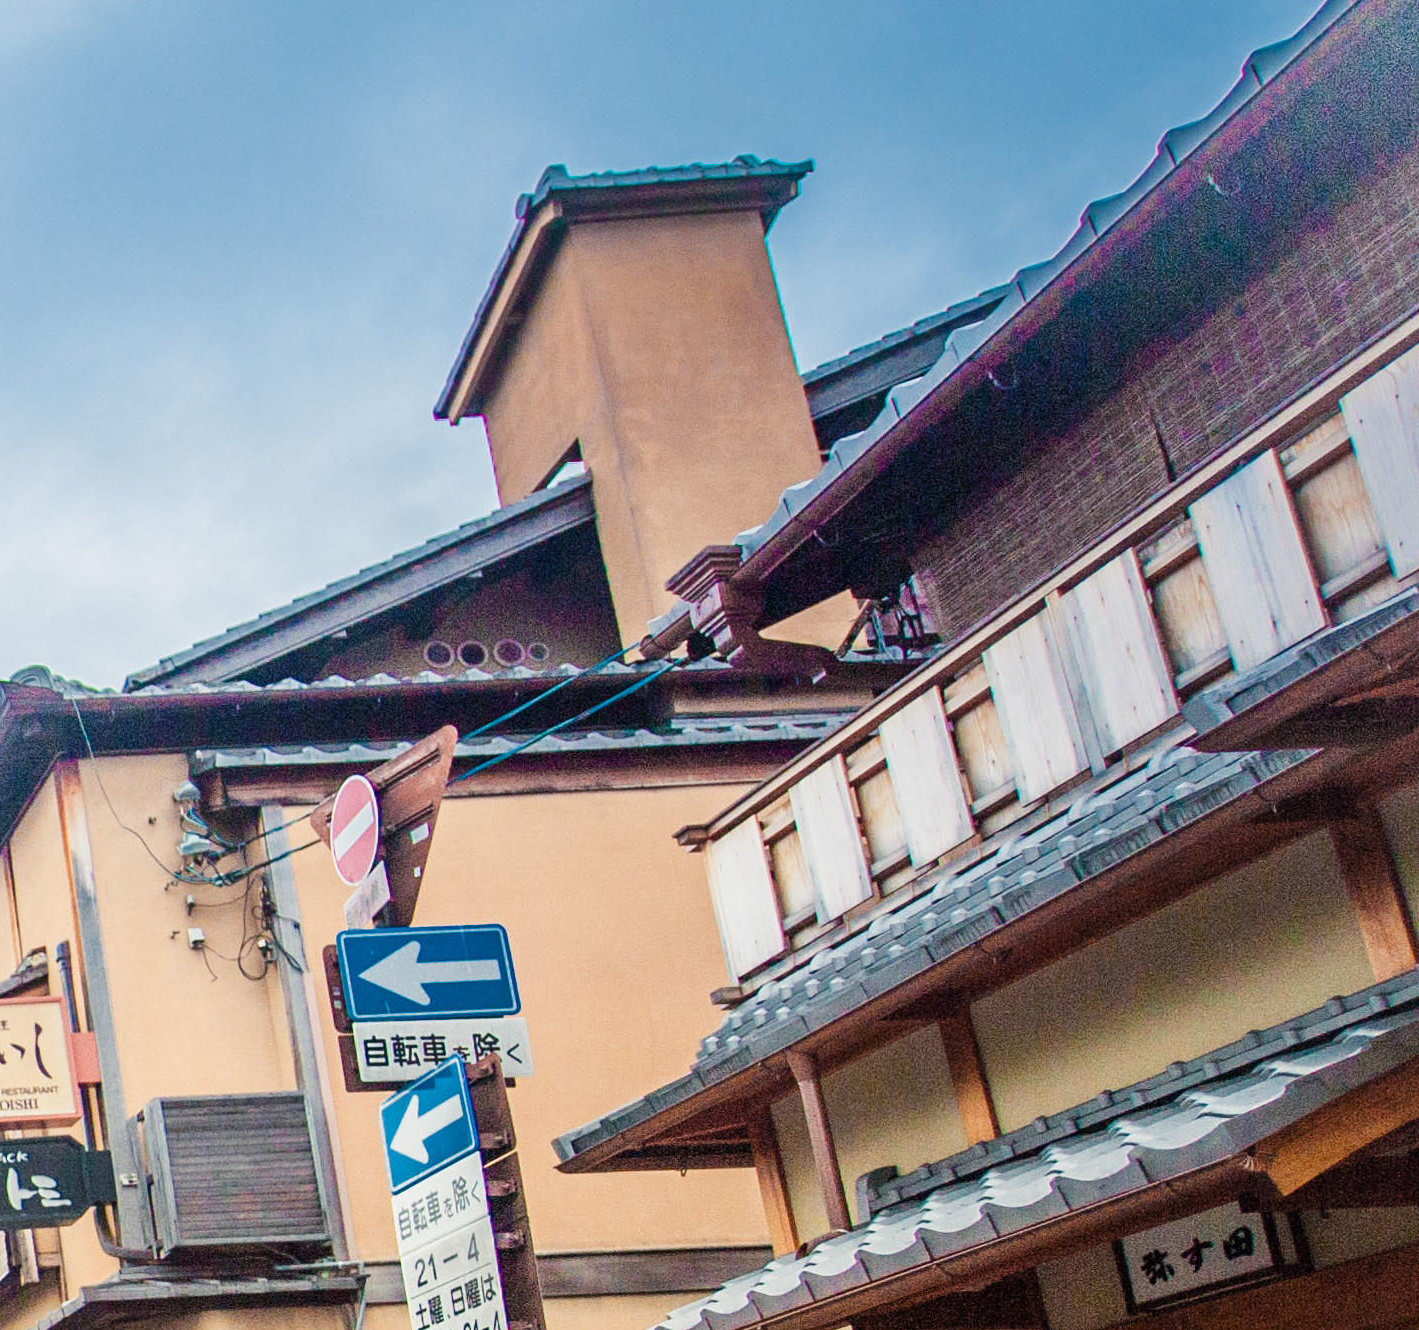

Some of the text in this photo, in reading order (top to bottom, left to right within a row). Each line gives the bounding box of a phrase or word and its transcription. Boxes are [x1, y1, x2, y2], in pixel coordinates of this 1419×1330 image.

[363, 1032, 523, 1067] 自転車を除く
[1, 1085, 59, 1096] RESTAURANT
[398, 1176, 481, 1240] 自転車を除く
